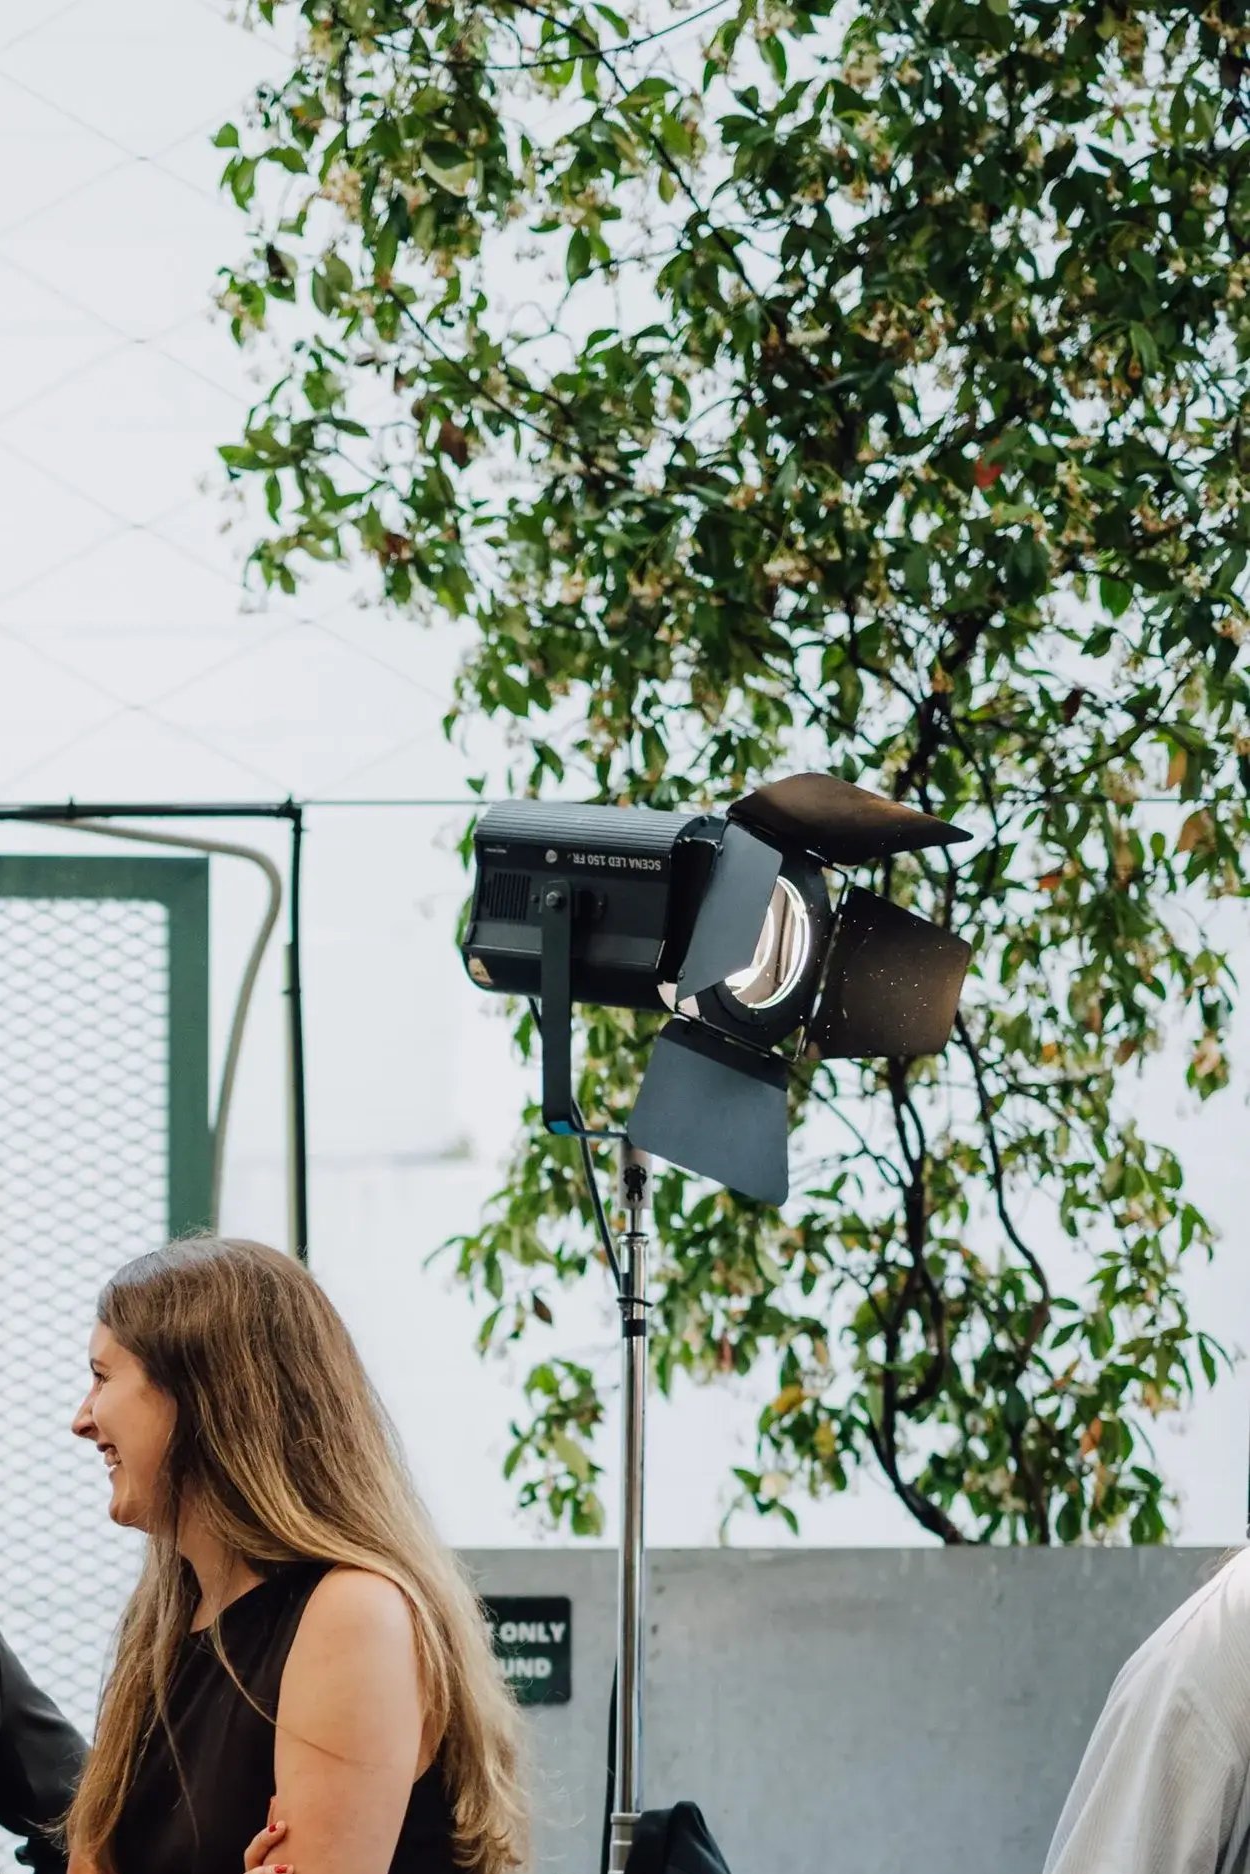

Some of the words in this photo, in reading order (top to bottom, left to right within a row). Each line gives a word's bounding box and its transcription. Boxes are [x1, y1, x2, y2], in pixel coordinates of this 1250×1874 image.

[572, 853, 586, 864] FR
[587, 854, 606, 866] 150
[608, 856, 627, 868] LED
[629, 858, 661, 871] SCENA
[500, 1622, 566, 1643] ONLY
[499, 1656, 552, 1678] UND
